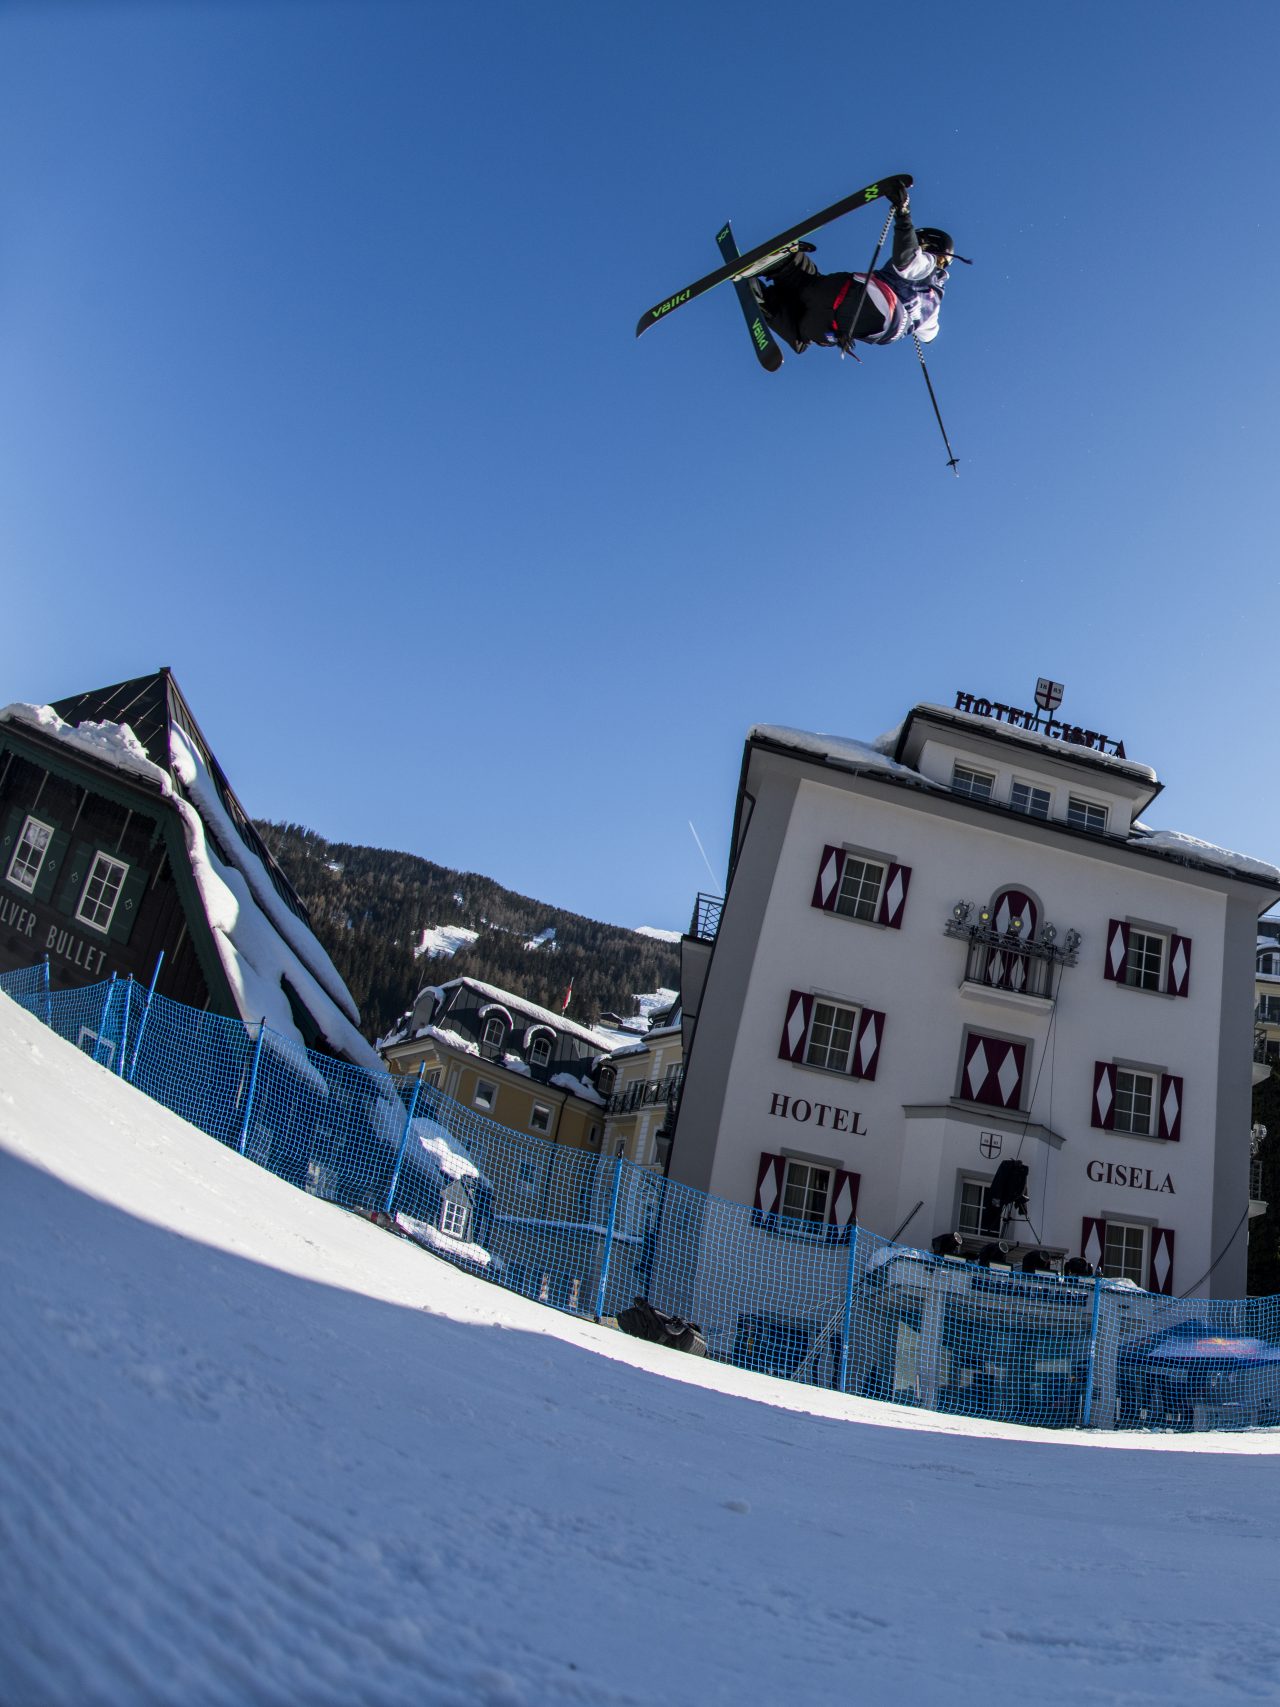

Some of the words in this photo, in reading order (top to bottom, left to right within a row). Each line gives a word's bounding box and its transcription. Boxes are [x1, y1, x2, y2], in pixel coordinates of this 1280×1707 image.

[955, 690, 1038, 732] HOTEL
[1044, 719, 1127, 760] GISELA
[45, 924, 107, 975] BULLET
[768, 1092, 868, 1137] HOTEL
[1086, 1160, 1177, 1194] GISELA
